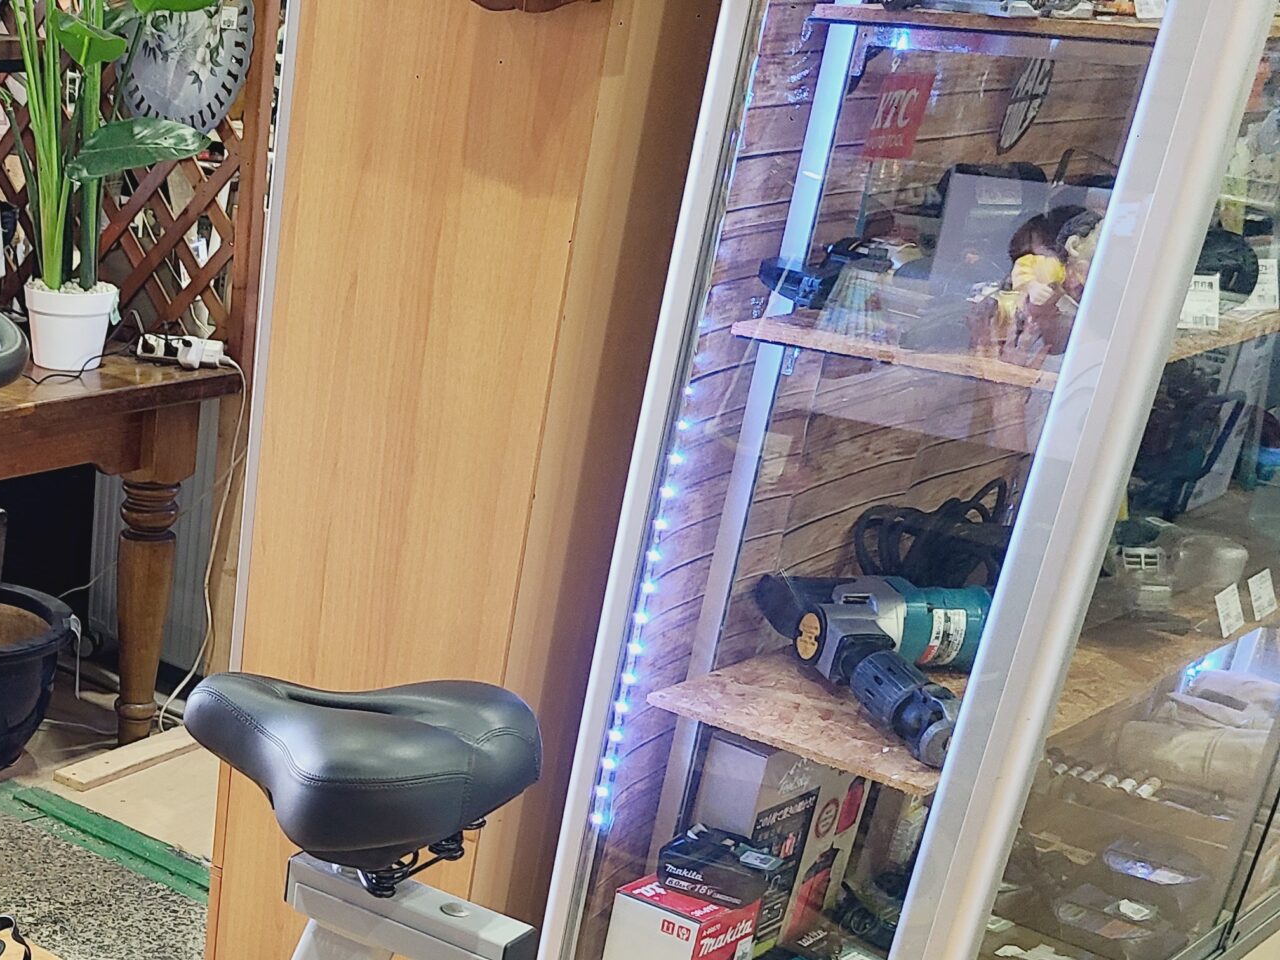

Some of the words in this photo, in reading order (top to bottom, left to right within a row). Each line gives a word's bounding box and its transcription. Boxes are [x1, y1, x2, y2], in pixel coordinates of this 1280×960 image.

[871, 87, 919, 130] KTC
[665, 863, 704, 882] makita
[699, 919, 753, 957] makita
